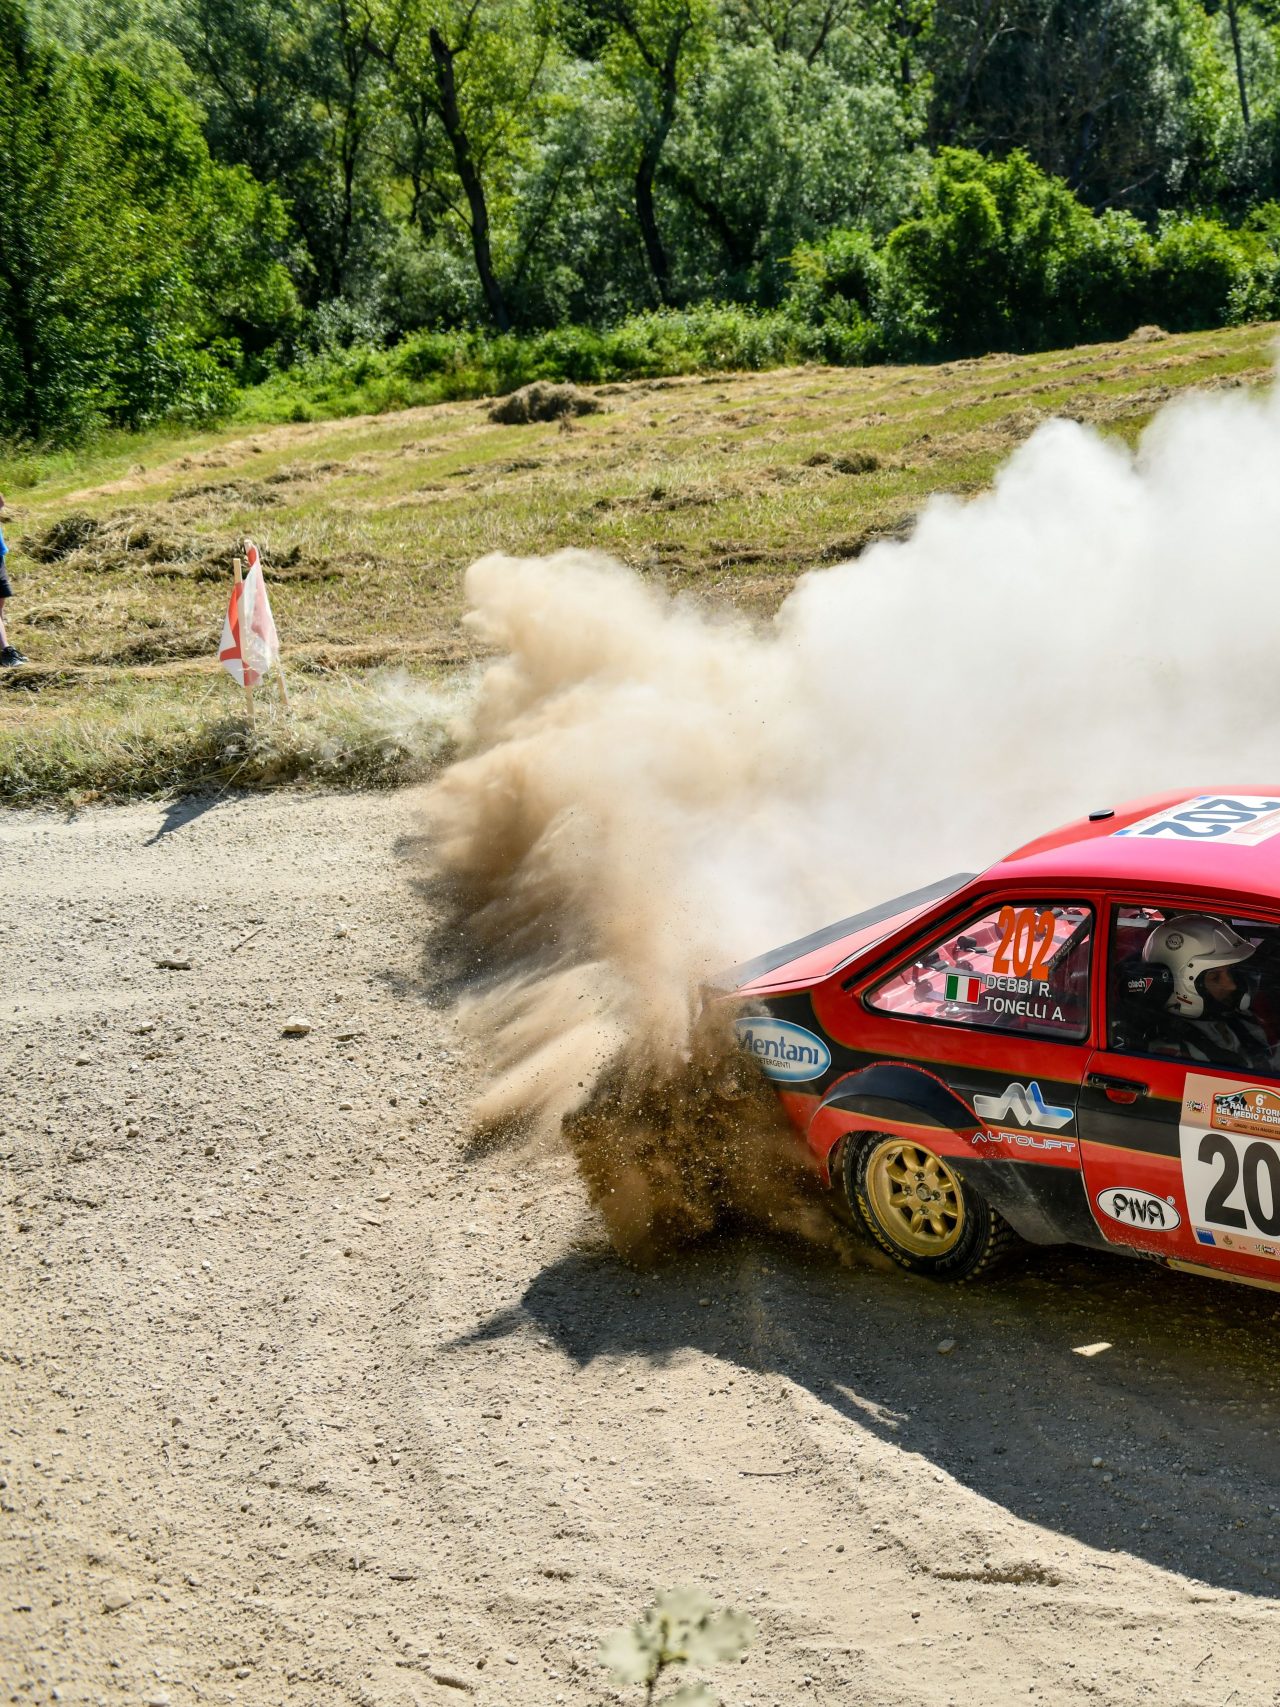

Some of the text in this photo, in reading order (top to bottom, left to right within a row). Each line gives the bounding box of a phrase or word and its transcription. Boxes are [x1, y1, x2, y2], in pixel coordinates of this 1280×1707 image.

[992, 905, 1055, 980] 202
[985, 974, 1052, 998] DEBBI R.
[985, 996, 1066, 1022] TONELLI A.
[737, 1029, 819, 1065] Mentani
[1216, 1107, 1231, 1116] DEL
[1234, 1110, 1260, 1121] MEDIO
[1230, 1101, 1254, 1112] RALLY
[972, 1131, 1076, 1152] AUTOLIFT
